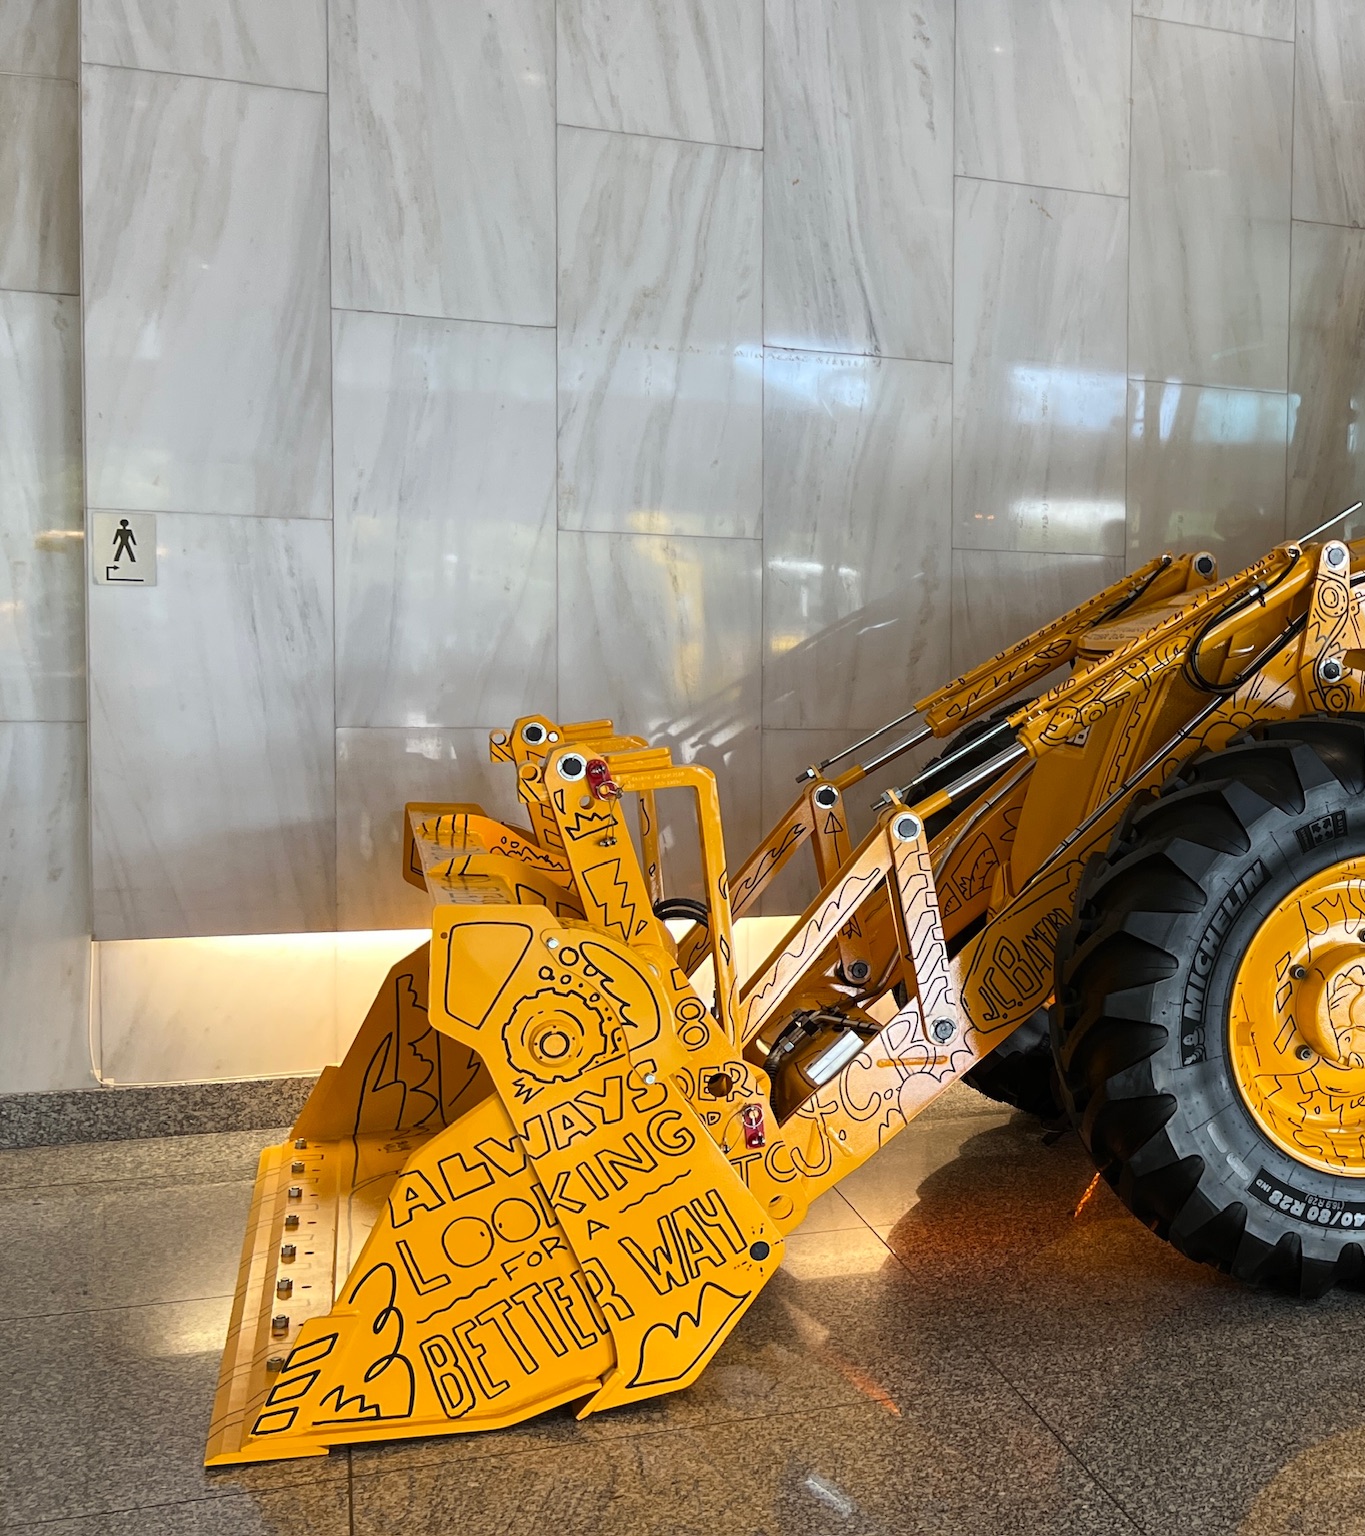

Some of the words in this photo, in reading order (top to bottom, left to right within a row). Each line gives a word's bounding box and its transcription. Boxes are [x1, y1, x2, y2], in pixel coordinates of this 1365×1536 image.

[1184, 860, 1268, 1019] MICHELIN
[388, 1058, 668, 1229] ALWAYS
[396, 1108, 696, 1296] LOOKING
[1255, 1177, 1273, 1194] IND
[1267, 1189, 1307, 1215] R28
[419, 1258, 633, 1419] BETTER
[619, 1189, 748, 1296] WAY
[500, 1236, 567, 1282] FOR
[587, 1218, 610, 1240] A
